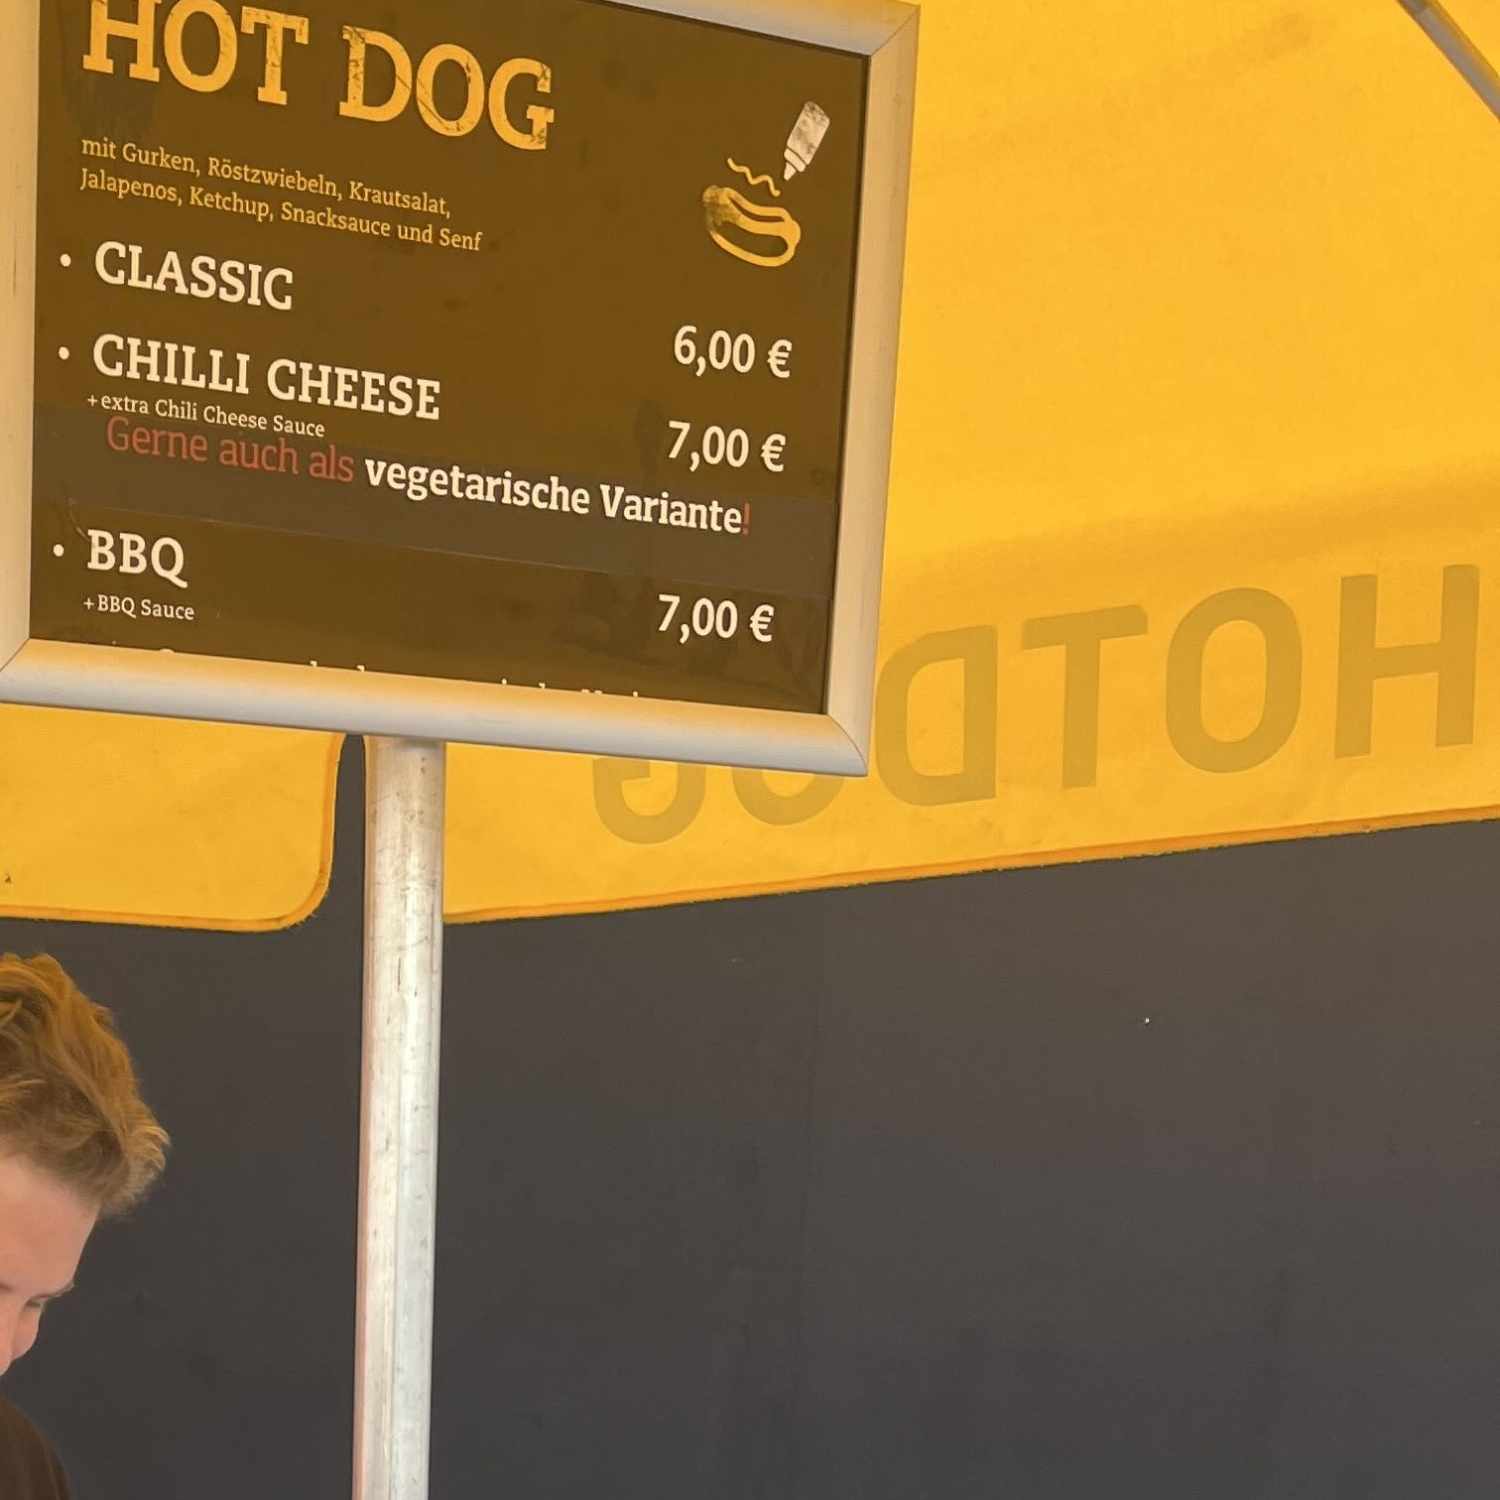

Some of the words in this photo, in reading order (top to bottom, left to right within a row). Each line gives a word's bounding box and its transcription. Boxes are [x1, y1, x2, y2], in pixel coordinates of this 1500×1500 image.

[82, 0, 309, 106] HOT
[339, 25, 555, 151] DOG
[80, 168, 182, 207] Jalapenos,
[190, 186, 275, 223] Ketchup,
[280, 202, 391, 237] Snacksauce
[398, 223, 434, 245] und
[439, 229, 483, 253] Senf
[81, 137, 116, 160] mit
[122, 143, 201, 178] Gurken,
[208, 157, 343, 201] Röstzwiebeln,
[349, 181, 452, 219] Krautsalat,
[95, 240, 294, 311] CLASSIC
[93, 333, 251, 395] CHILLI
[267, 358, 441, 420] CHEESE
[673, 324, 756, 377] 6,00
[767, 338, 793, 378] €
[155, 399, 198, 422] Chili
[203, 405, 268, 431] Cheese
[273, 415, 325, 438] Sauce
[668, 420, 750, 472] 7,00
[760, 433, 787, 473] €
[106, 415, 208, 462] Gerne
[218, 436, 299, 476] auch
[309, 445, 355, 483] als
[364, 458, 590, 515] vegetarische
[600, 484, 752, 536] Variante!
[87, 529, 188, 589] BBQ
[141, 599, 195, 622] Sauce
[658, 594, 738, 644] 7,00
[749, 603, 775, 643] €
